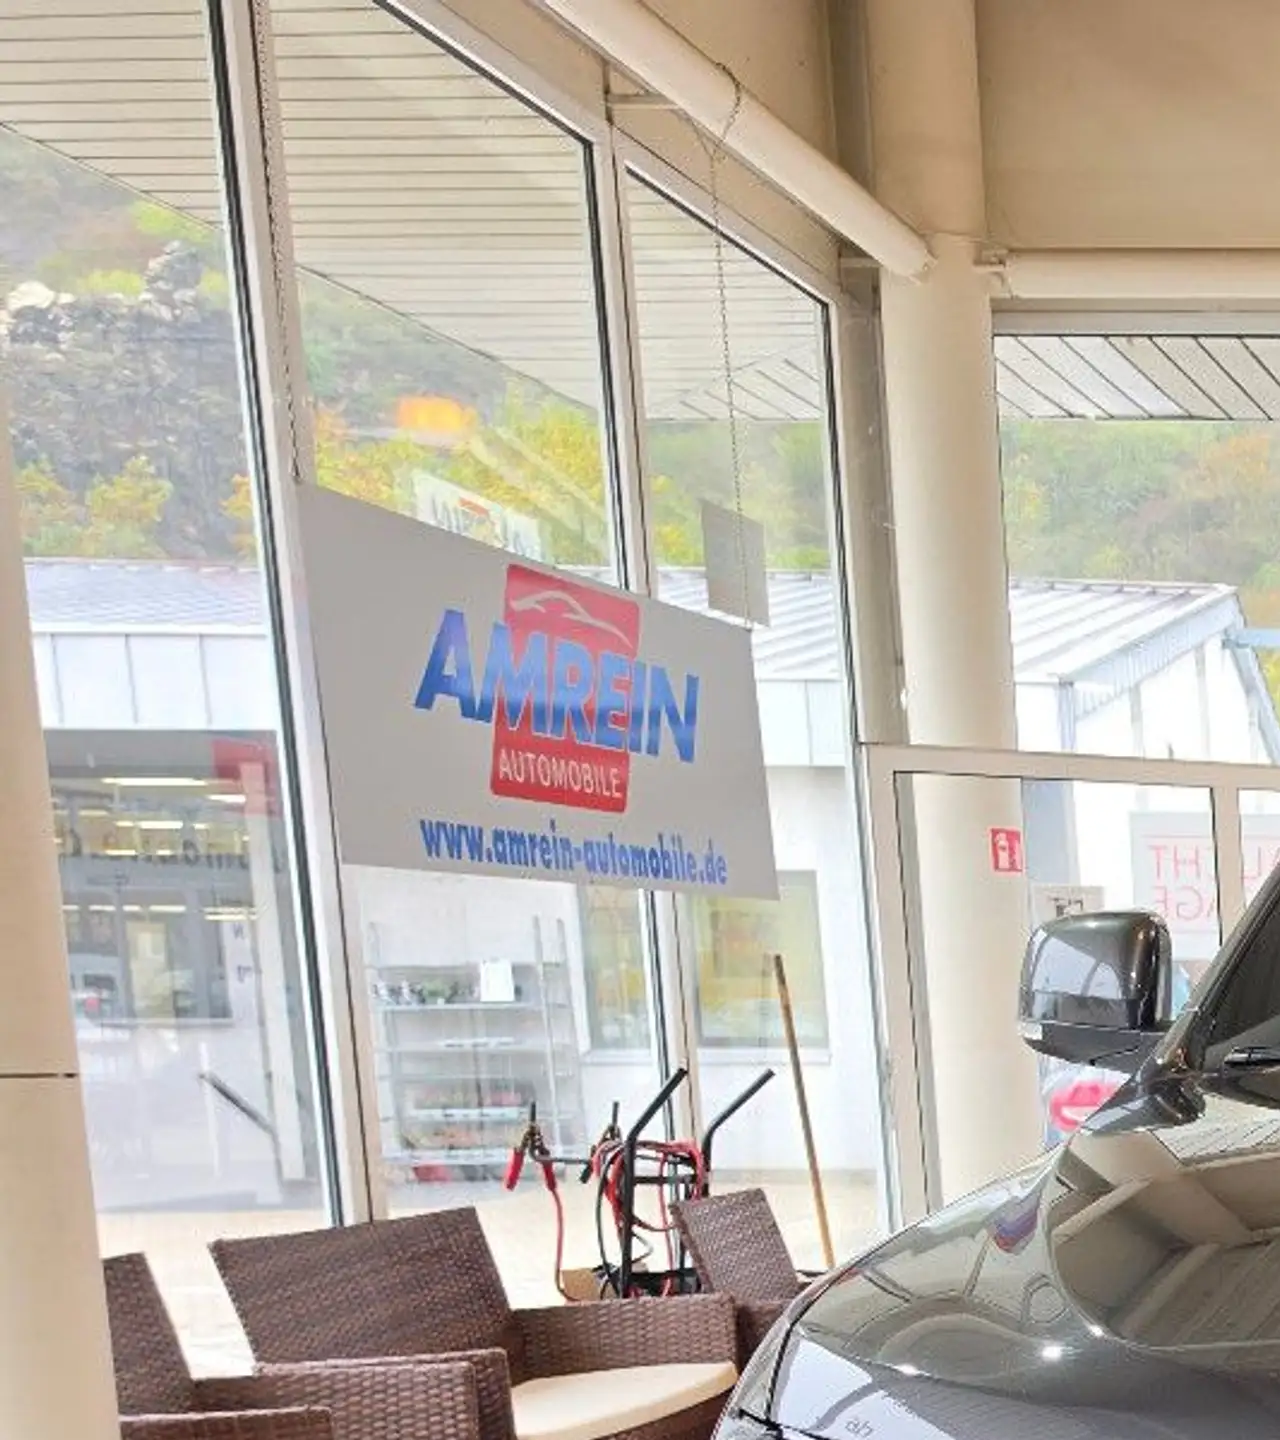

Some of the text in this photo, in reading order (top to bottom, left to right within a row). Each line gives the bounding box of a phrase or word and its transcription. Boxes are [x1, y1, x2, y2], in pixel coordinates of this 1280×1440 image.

[414, 608, 699, 764] AMREIN
[498, 748, 623, 799] AUTOMOBILE
[419, 818, 728, 886] www.amrein-automobile.de
